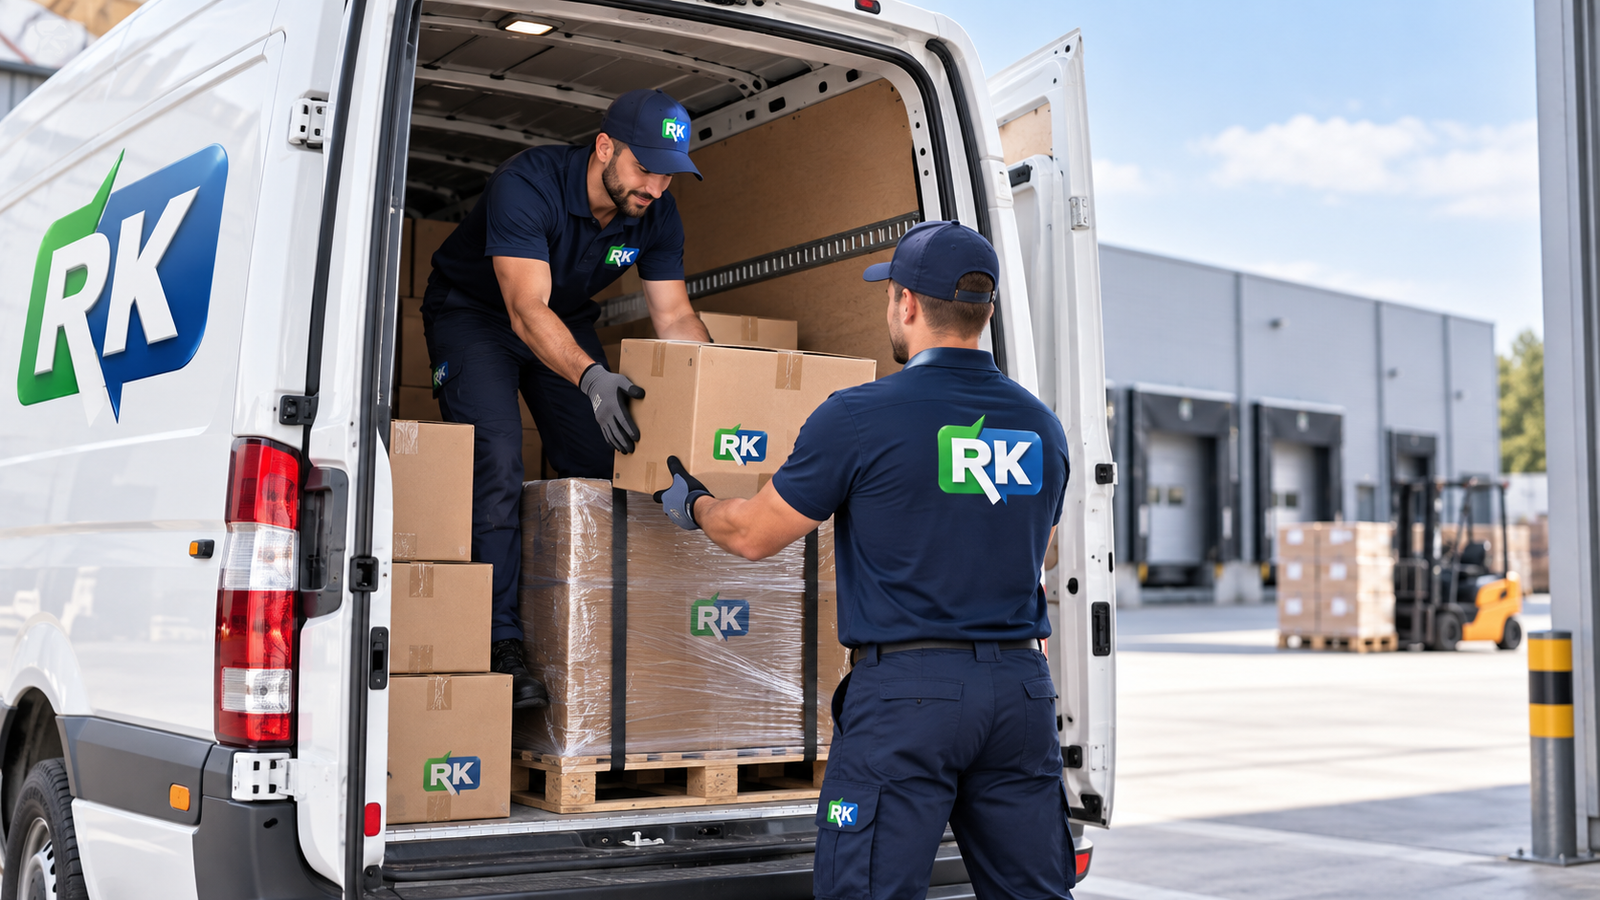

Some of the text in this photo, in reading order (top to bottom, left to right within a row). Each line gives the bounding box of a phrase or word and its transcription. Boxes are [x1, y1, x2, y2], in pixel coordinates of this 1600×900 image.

[665, 122, 685, 142] RK
[609, 250, 635, 267] RK
[34, 186, 200, 427] RK
[719, 434, 762, 466] RK
[951, 437, 1033, 505] RK
[697, 606, 743, 642] RK
[430, 762, 474, 796] RK
[830, 804, 855, 828] RK
